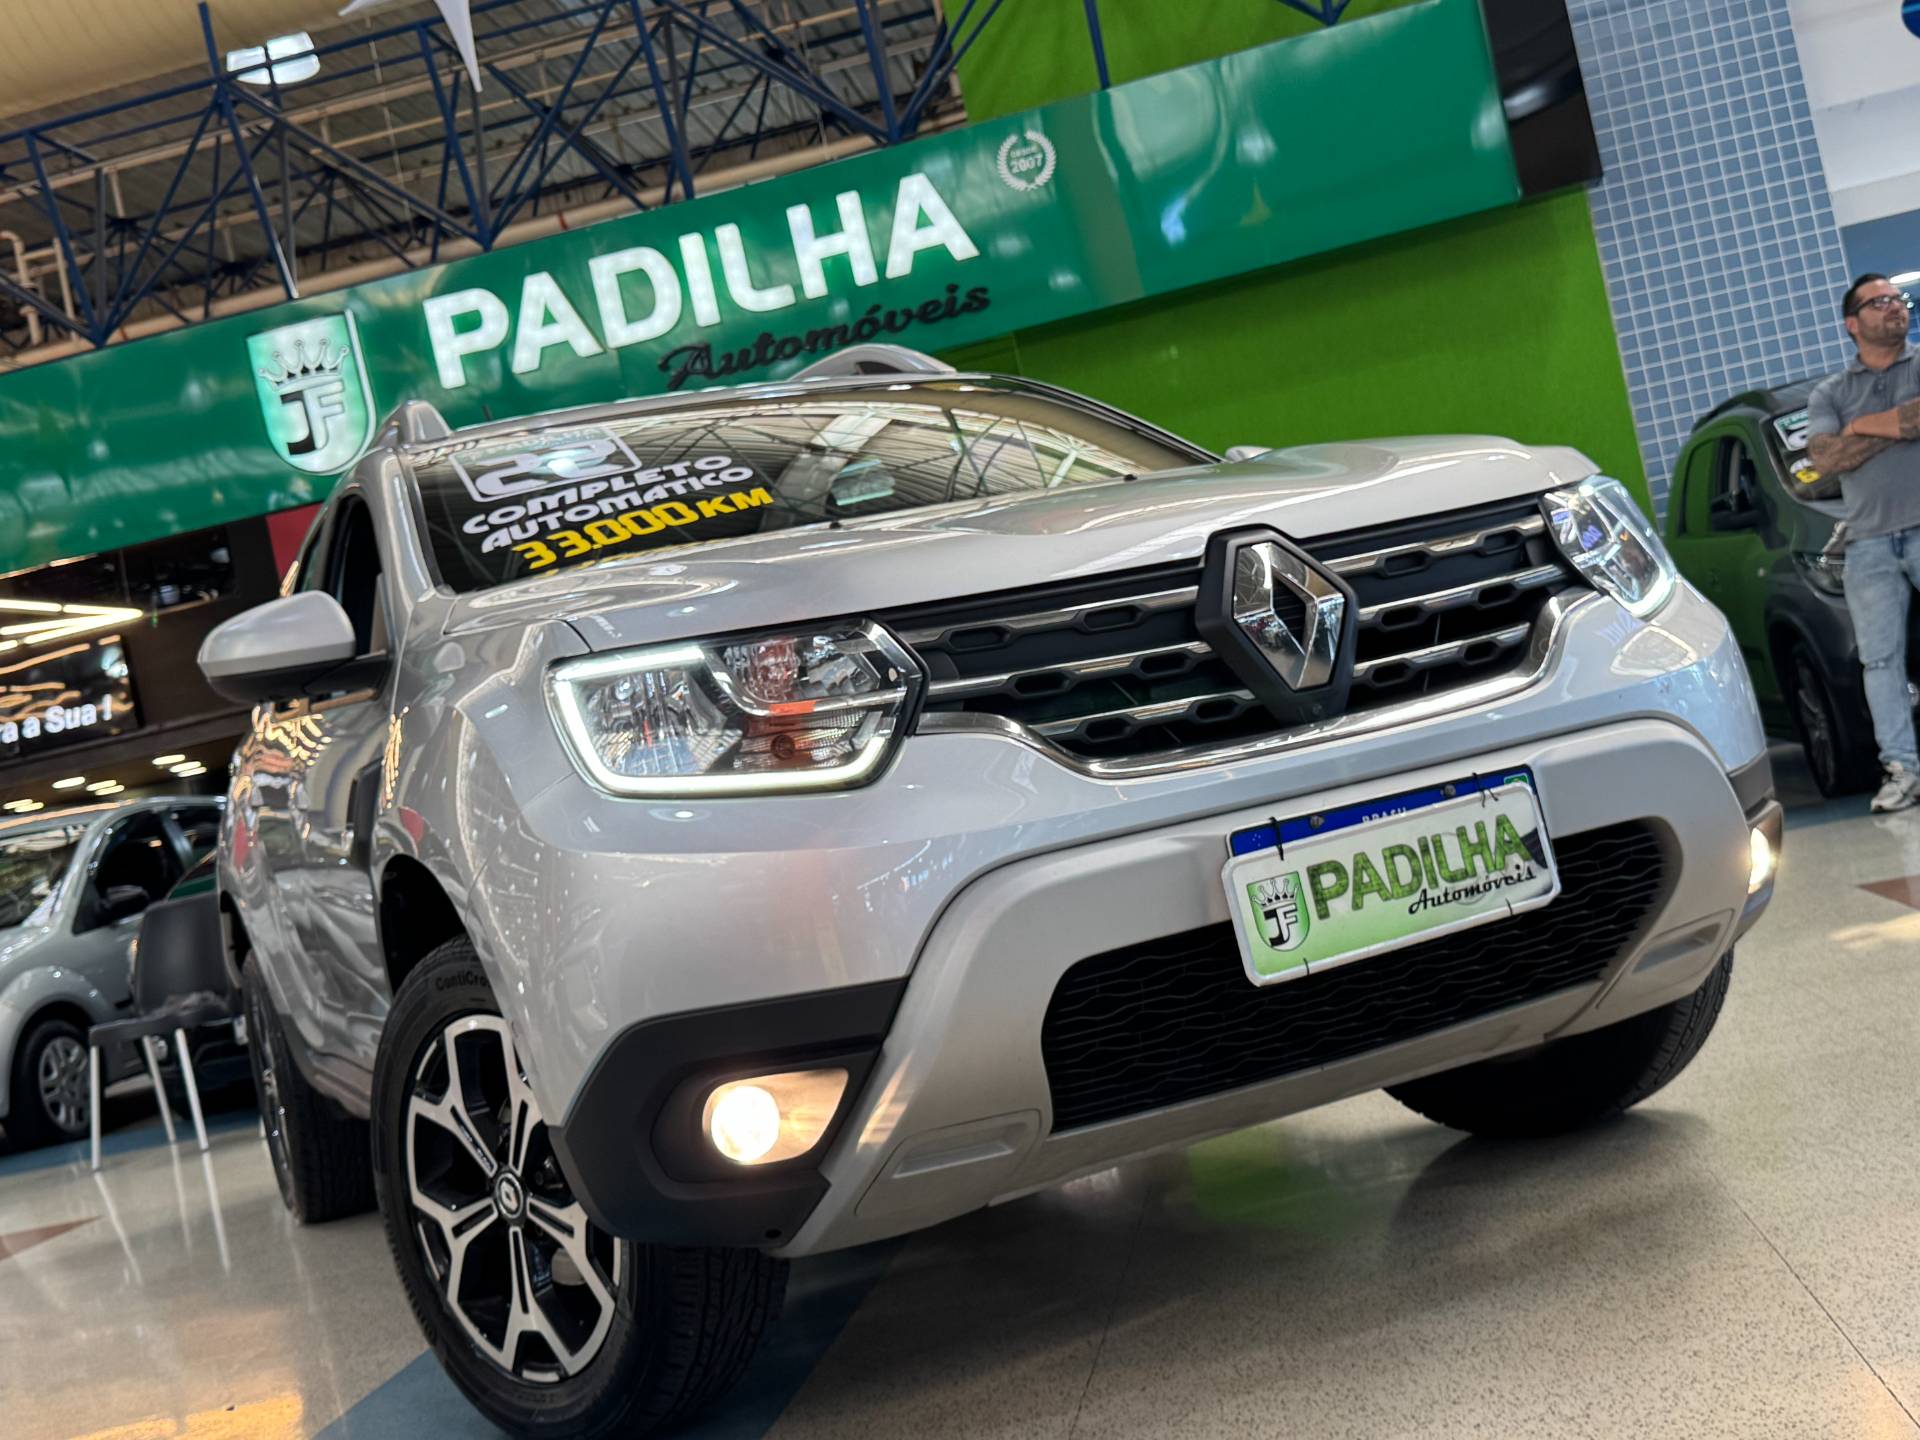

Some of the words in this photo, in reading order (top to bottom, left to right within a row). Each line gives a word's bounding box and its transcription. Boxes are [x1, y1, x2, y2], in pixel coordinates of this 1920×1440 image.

[1009, 153, 1043, 174] 2007
[423, 173, 980, 388] PADILHA
[657, 283, 991, 391] Automóveis
[462, 455, 733, 535] COMPLETO
[480, 466, 756, 554] AUTOMATICO
[22, 716, 41, 739] a
[1307, 814, 1533, 921] PADILHA
[1408, 864, 1538, 915] Automóveis
[435, 969, 491, 992] ContiCro
